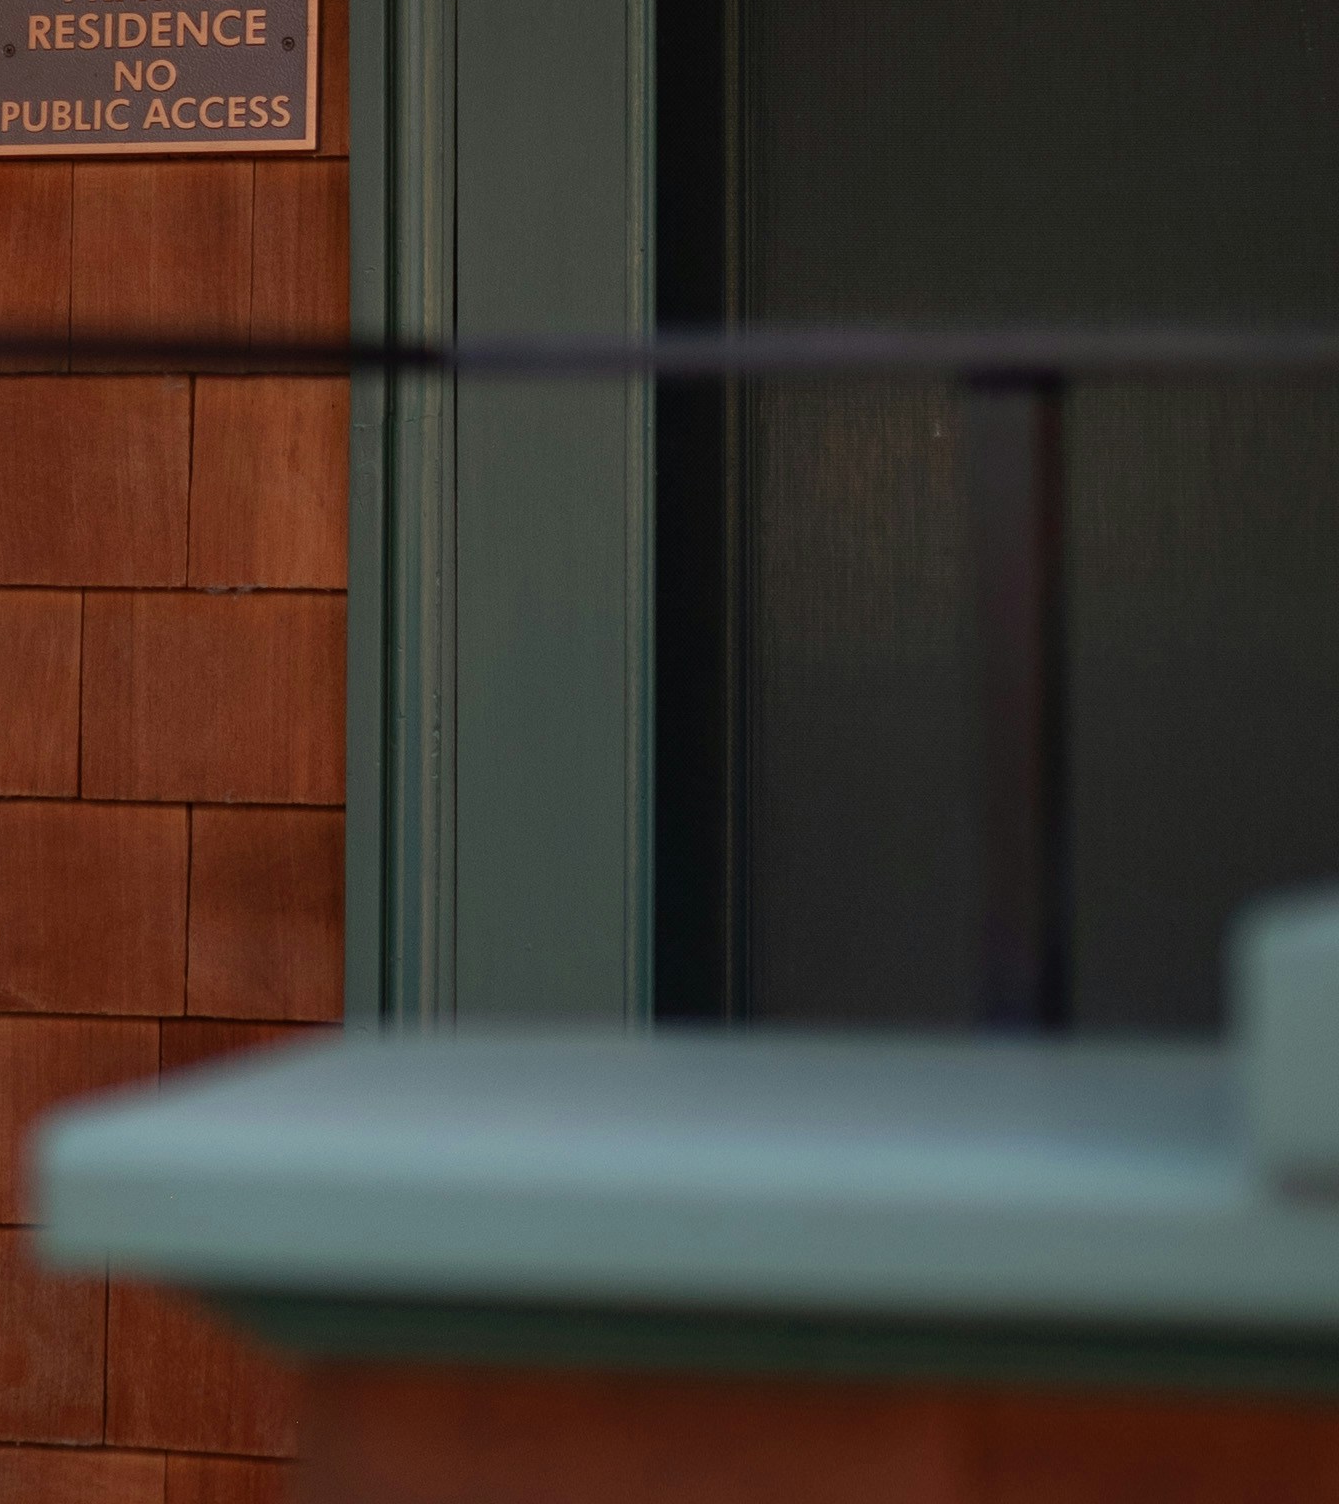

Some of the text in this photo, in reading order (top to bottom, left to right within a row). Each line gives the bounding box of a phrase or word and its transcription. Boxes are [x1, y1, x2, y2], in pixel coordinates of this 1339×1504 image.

[27, 8, 267, 50] RESIDENCE
[114, 58, 178, 92] NO
[0, 94, 292, 133] PUBLIC ACCESS
